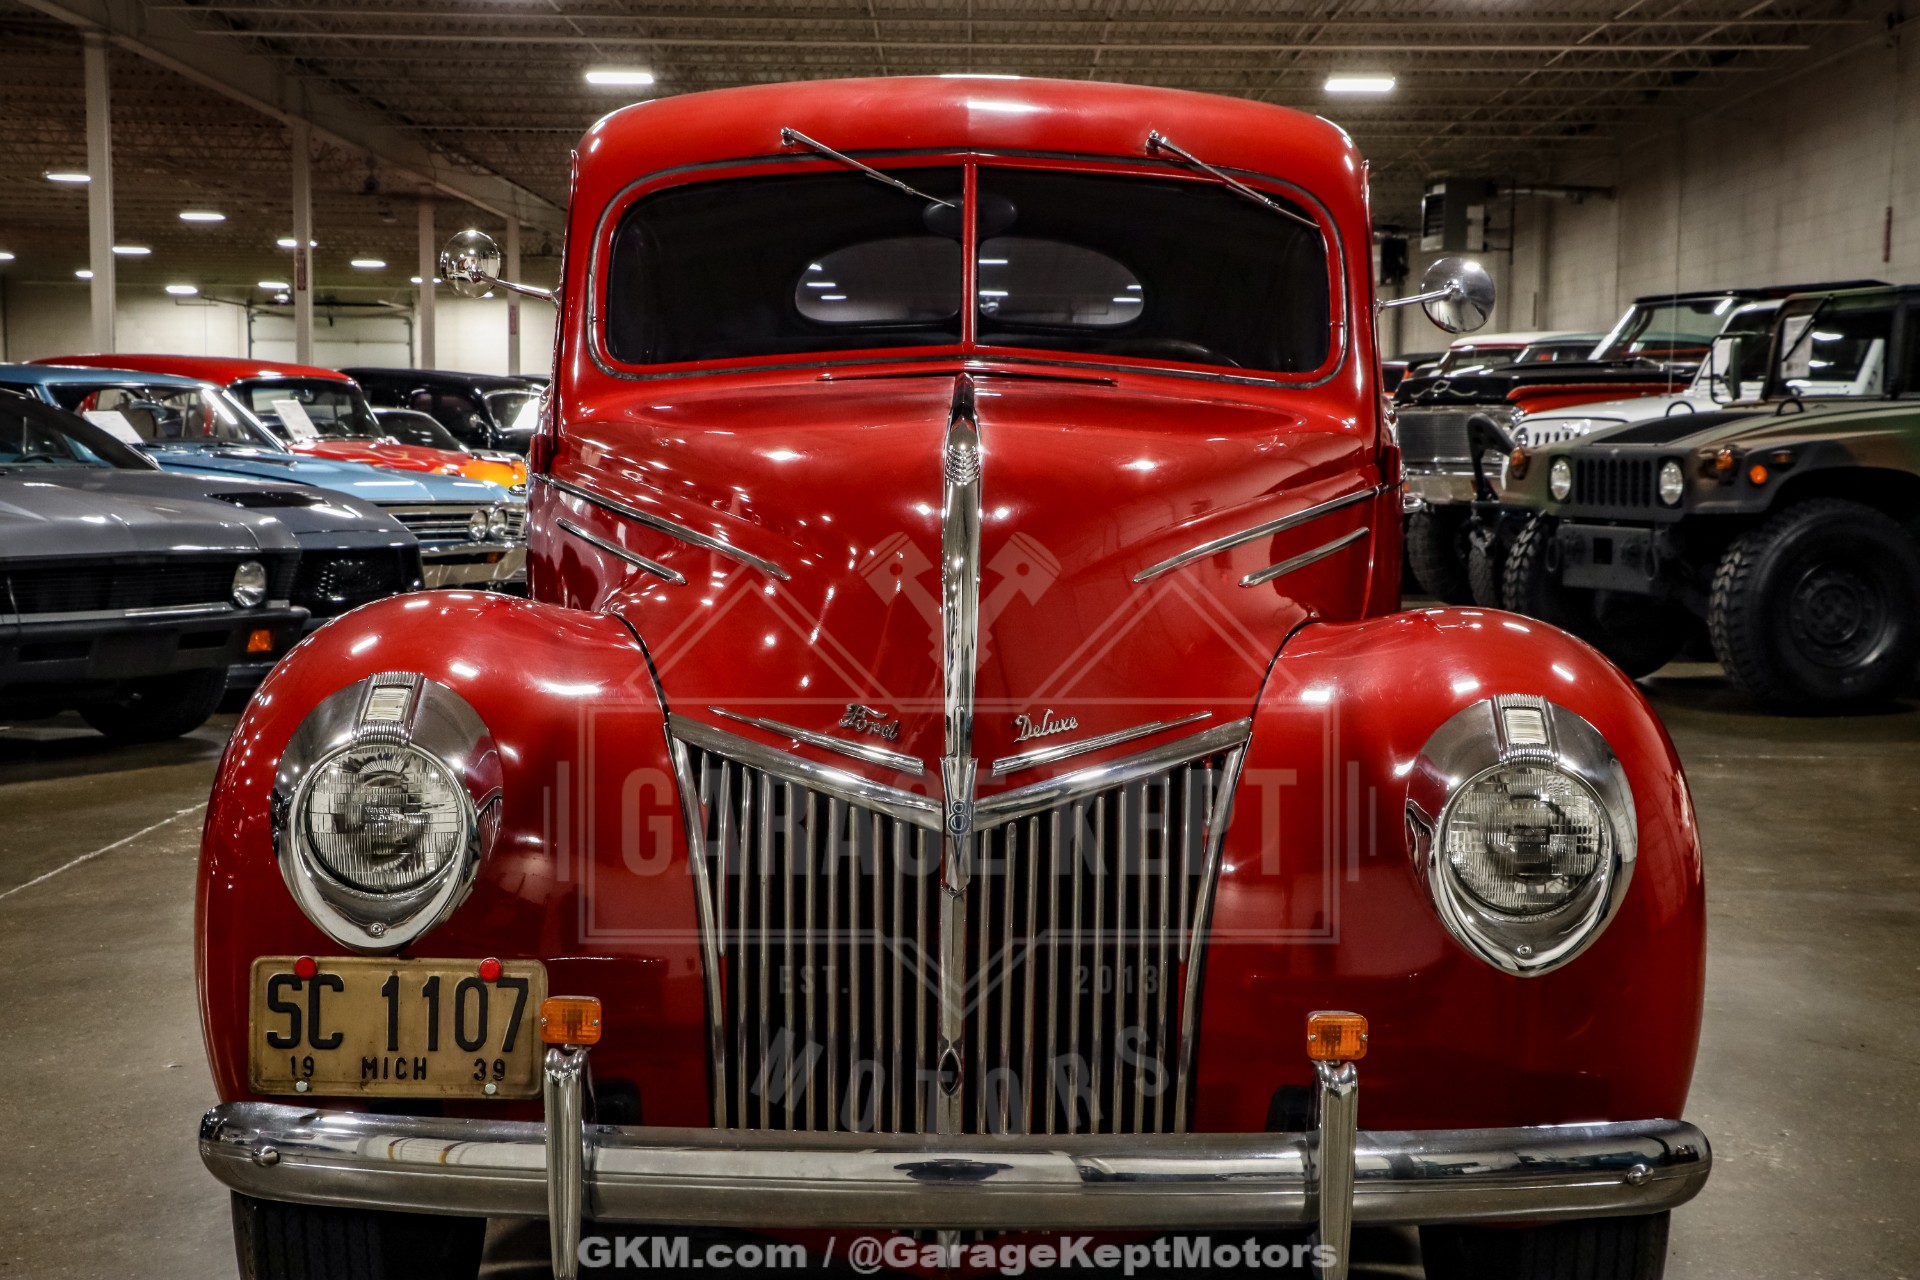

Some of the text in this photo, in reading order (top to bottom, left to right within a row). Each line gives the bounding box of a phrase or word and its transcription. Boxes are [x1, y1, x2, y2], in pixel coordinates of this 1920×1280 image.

[838, 703, 899, 740] Ford
[1013, 708, 1079, 743] Deluxe
[266, 973, 530, 1053] SC 1107
[290, 1055, 507, 1082] 19 MICH 39
